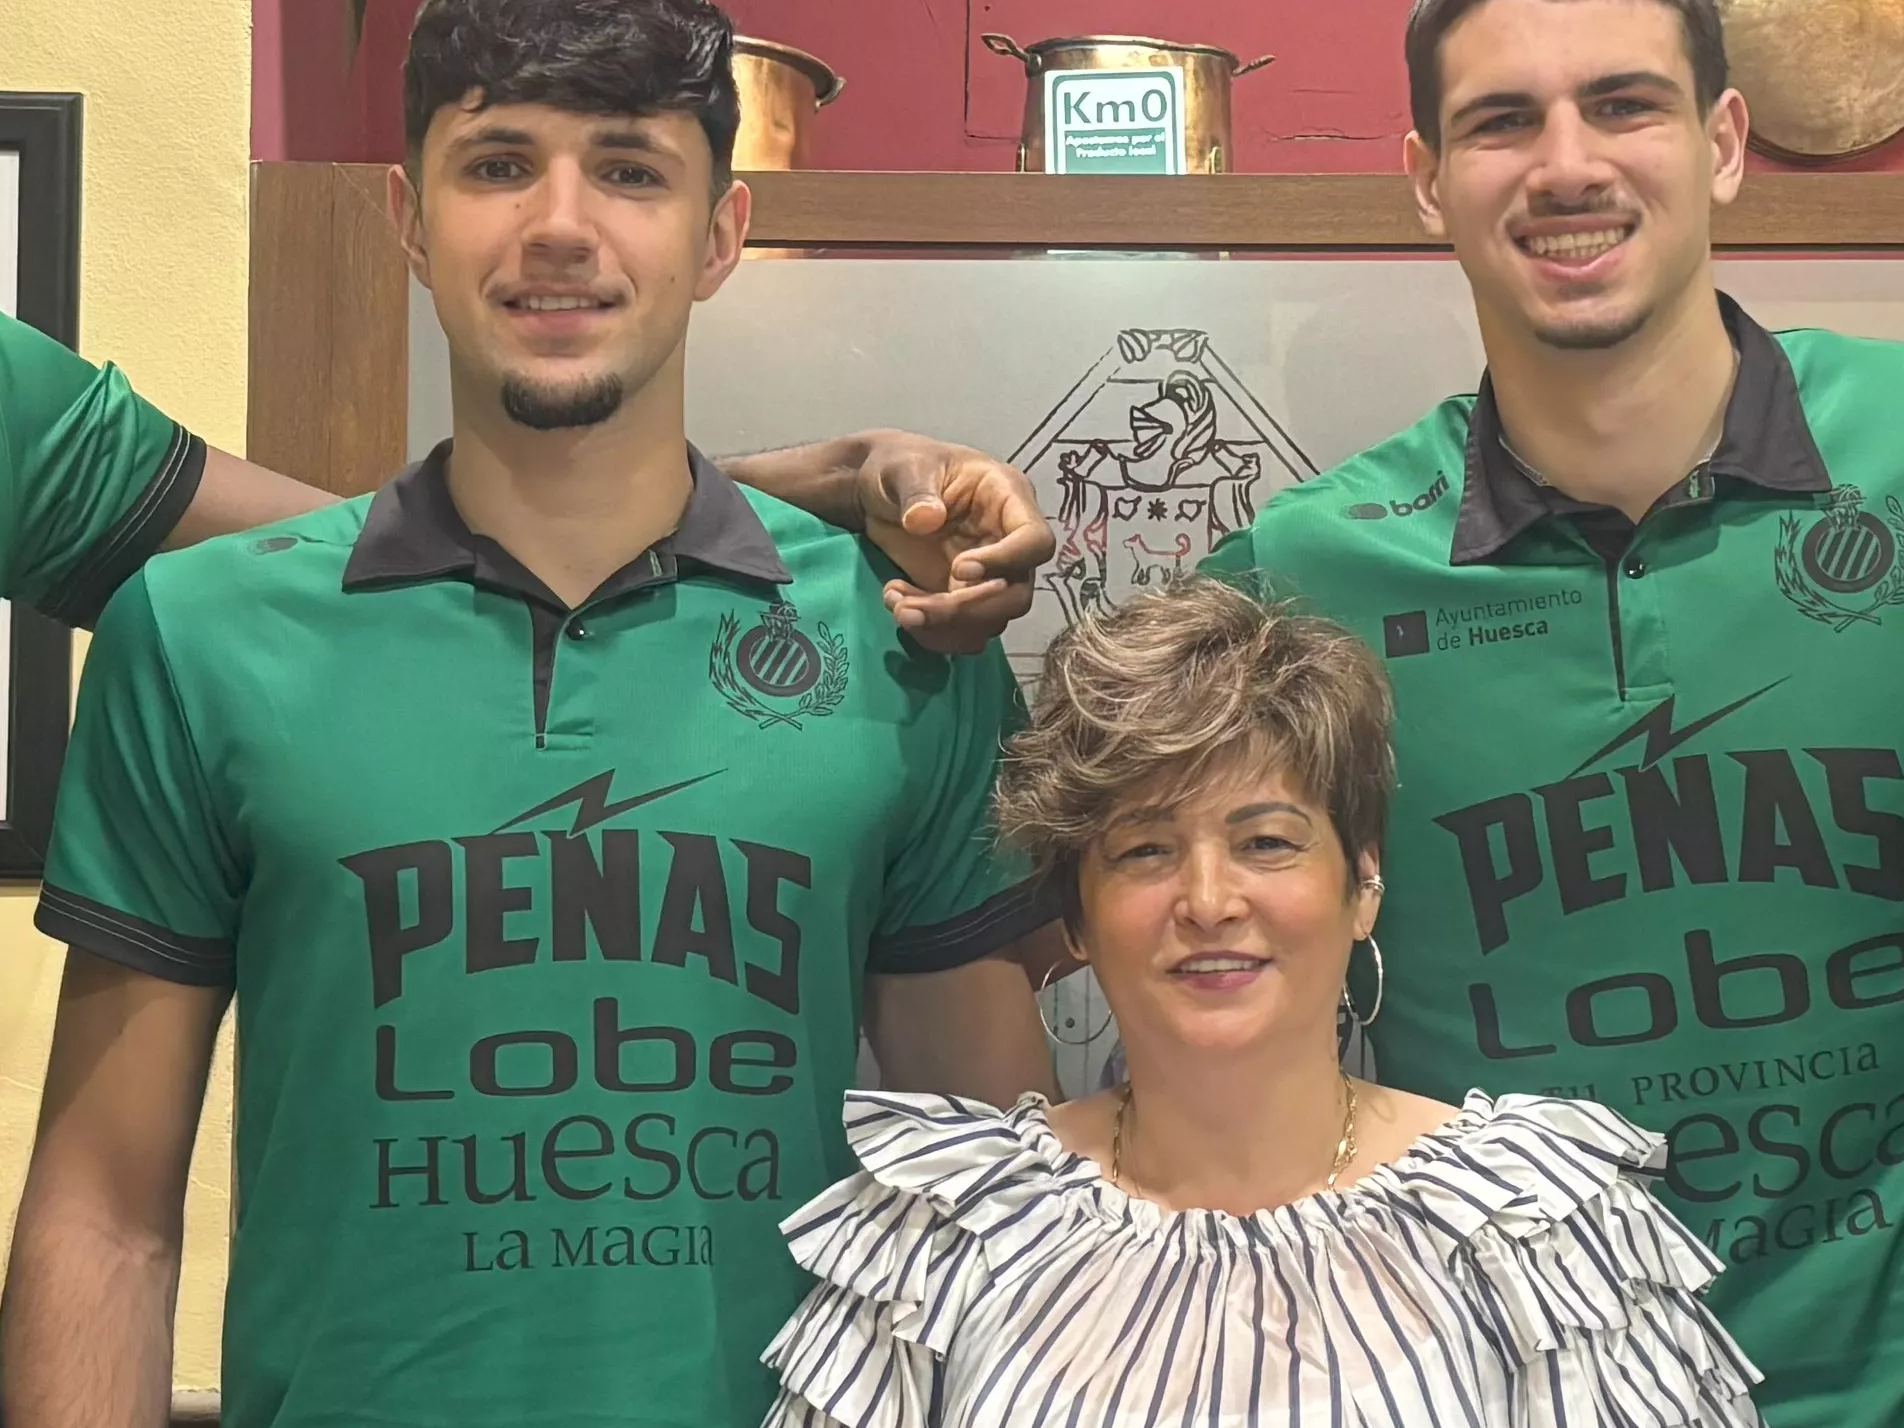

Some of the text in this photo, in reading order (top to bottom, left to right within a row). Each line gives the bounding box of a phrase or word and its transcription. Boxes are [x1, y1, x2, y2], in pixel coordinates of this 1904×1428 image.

[1435, 588, 1583, 628] Ayuntamiento
[1437, 619, 1549, 651] de Huesca
[373, 996, 798, 1102] Lobe
